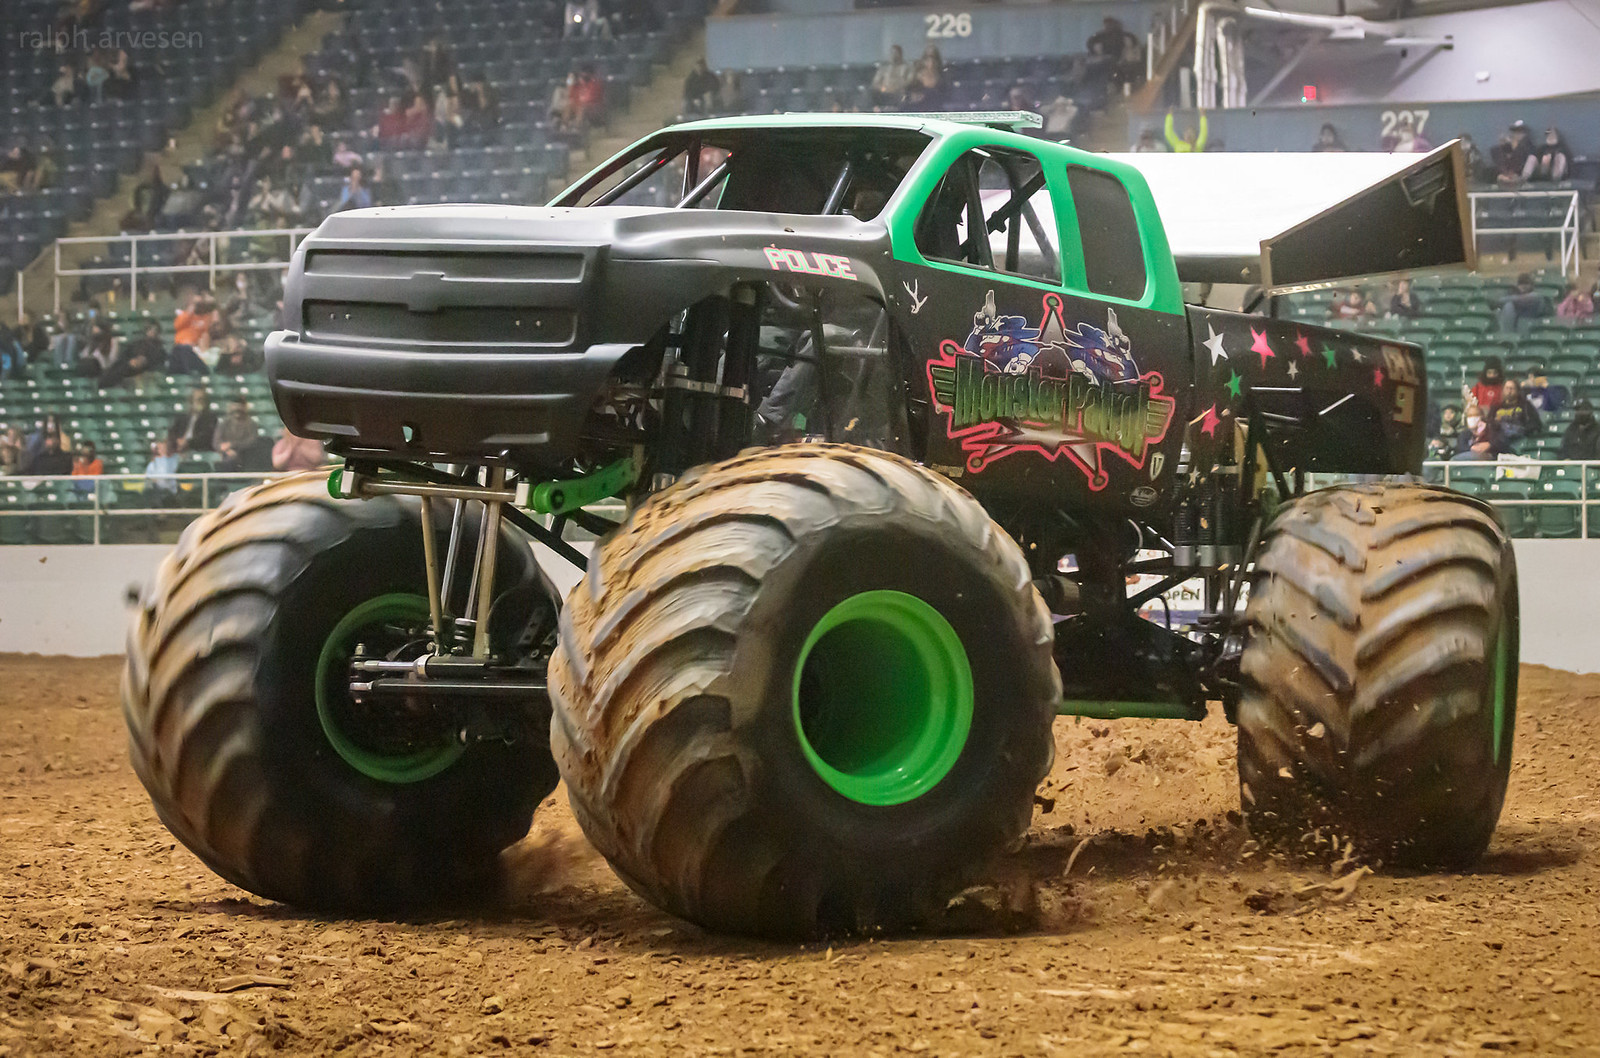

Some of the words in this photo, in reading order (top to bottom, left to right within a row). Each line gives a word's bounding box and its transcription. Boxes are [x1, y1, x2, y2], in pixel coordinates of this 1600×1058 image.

[924, 13, 972, 38] 226
[763, 247, 857, 280] POLICE
[1163, 587, 1201, 602] OPEN
